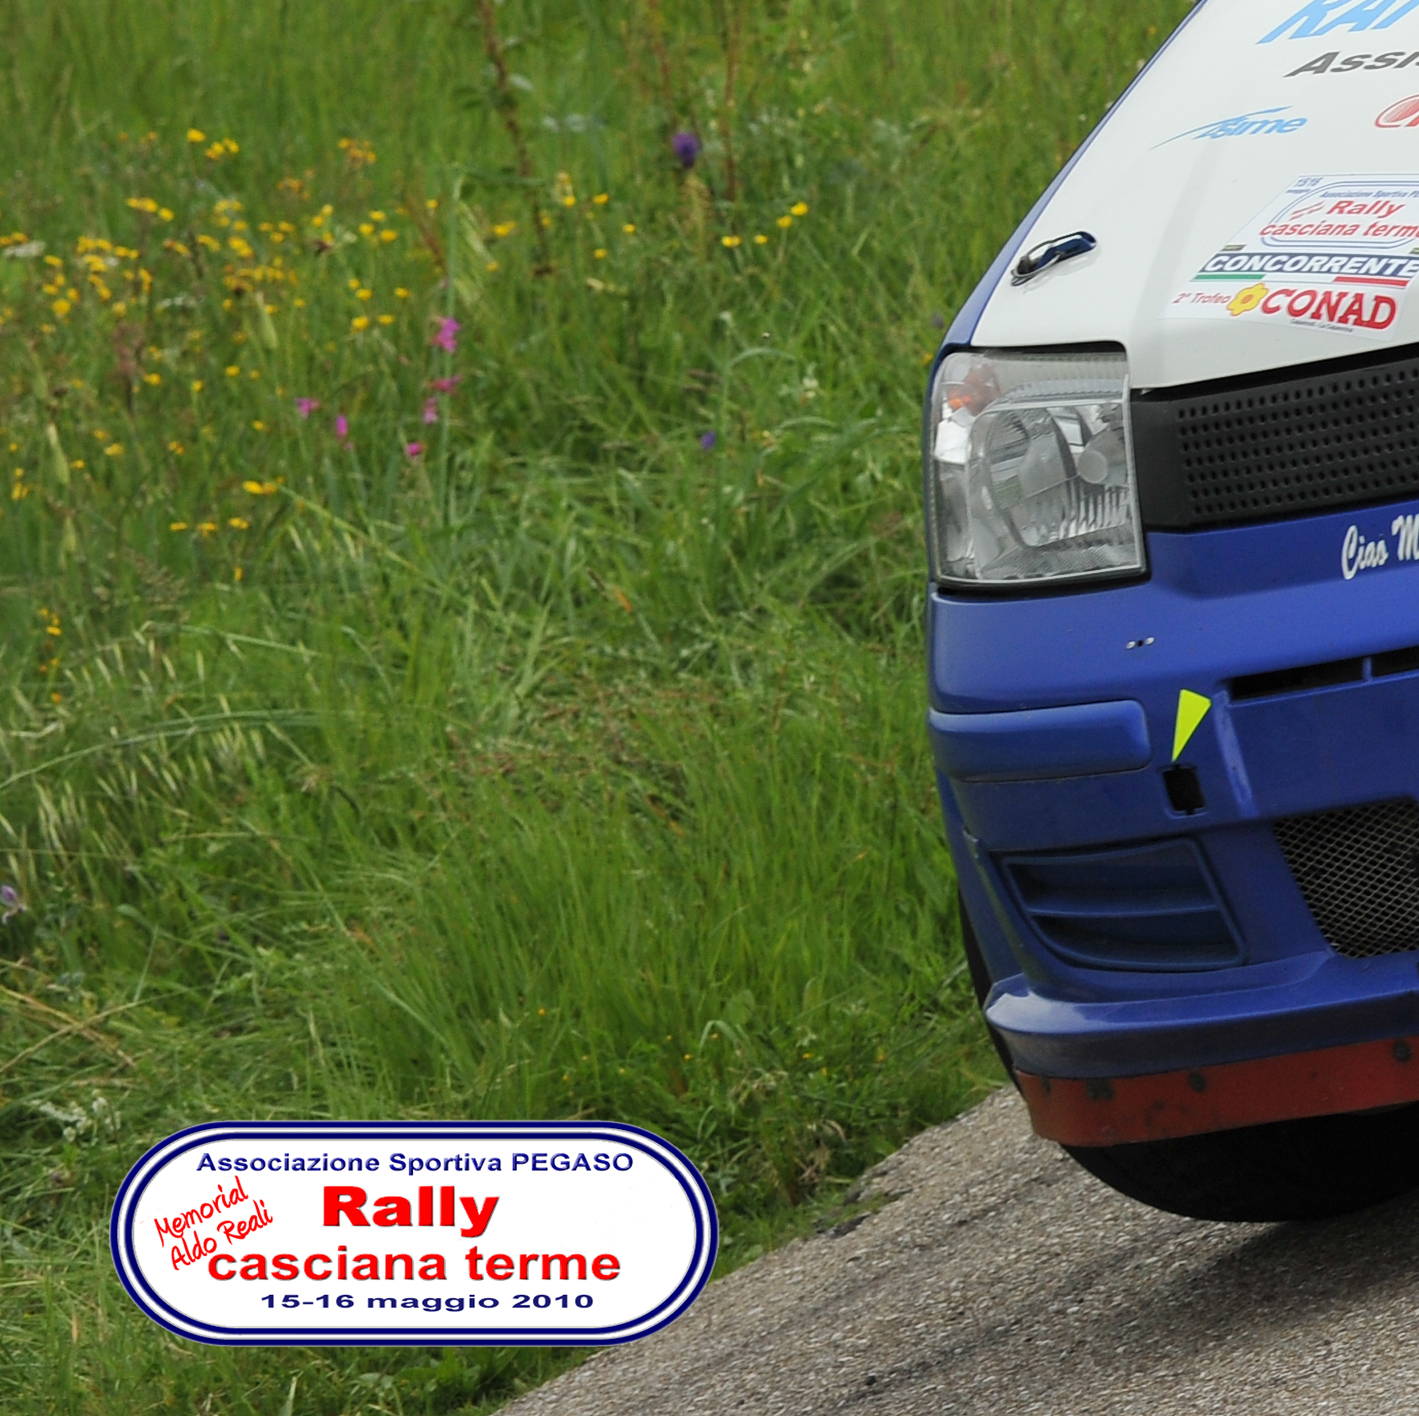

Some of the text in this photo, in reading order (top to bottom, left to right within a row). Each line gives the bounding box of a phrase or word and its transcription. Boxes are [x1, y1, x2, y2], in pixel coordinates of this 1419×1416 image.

[1325, 200, 1406, 219] Rally
[1259, 220, 1359, 239] casciana
[1191, 292, 1233, 306] Trofeo
[1261, 287, 1397, 330] CONAD
[1341, 525, 1389, 580] Ciao
